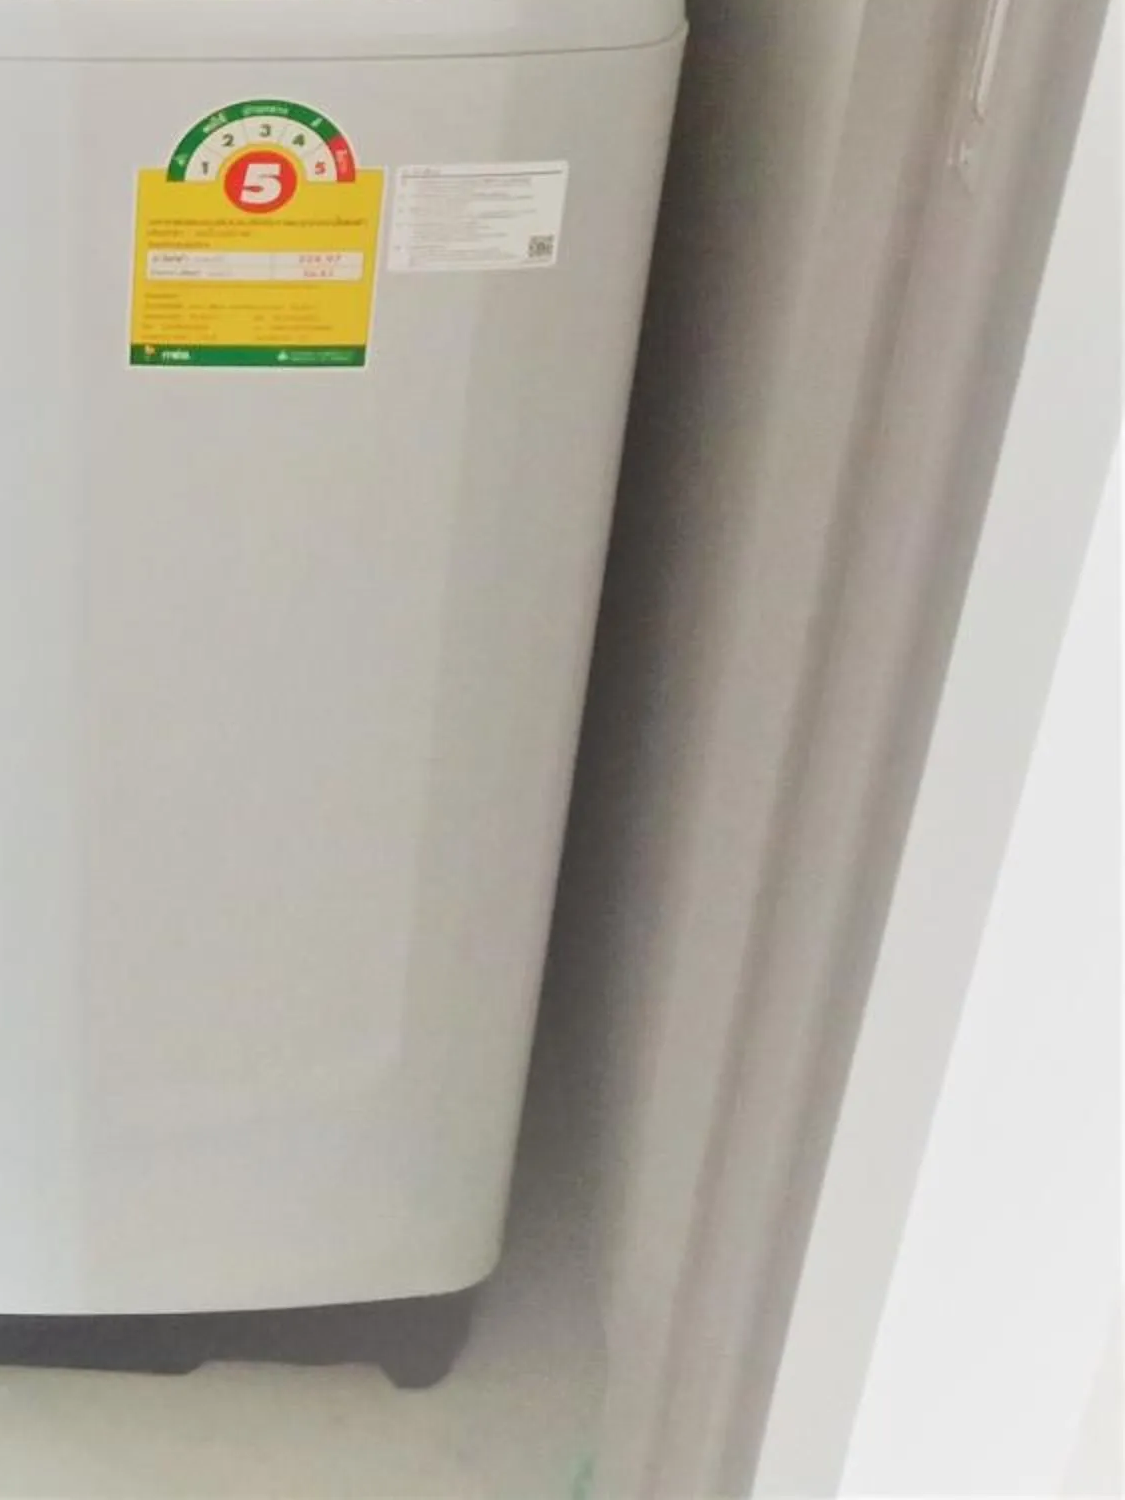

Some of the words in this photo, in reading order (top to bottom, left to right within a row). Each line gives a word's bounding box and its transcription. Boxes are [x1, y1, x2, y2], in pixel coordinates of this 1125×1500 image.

[201, 161, 209, 175] 1
[222, 134, 235, 147] 2
[259, 124, 272, 137] 3
[291, 133, 306, 146] 4
[314, 161, 327, 175] 5
[239, 163, 283, 204] 5
